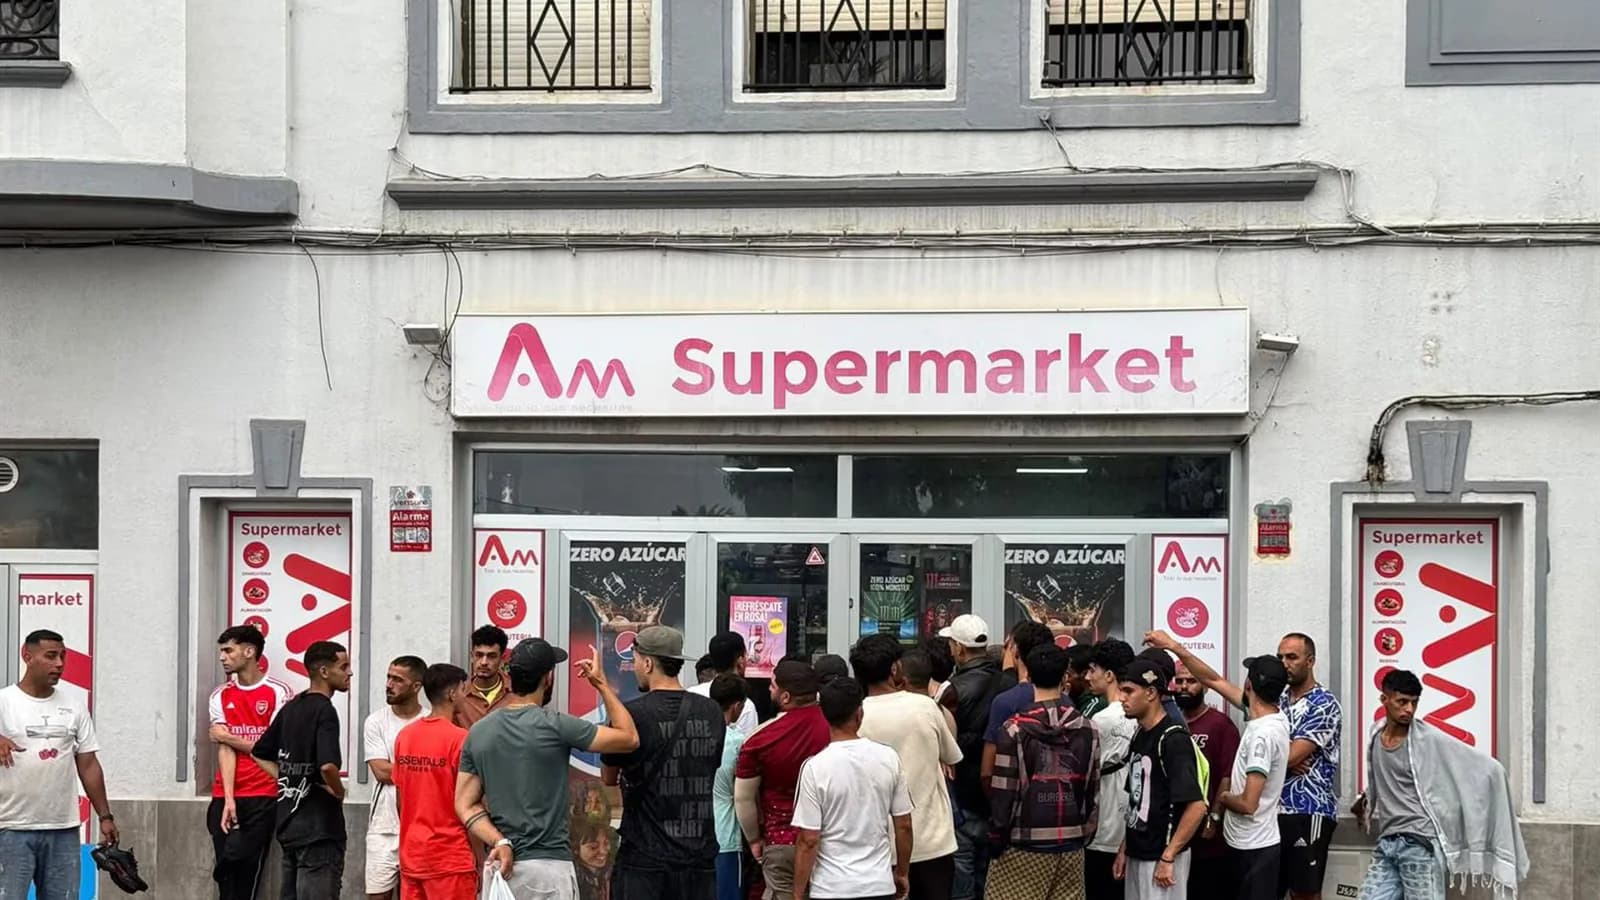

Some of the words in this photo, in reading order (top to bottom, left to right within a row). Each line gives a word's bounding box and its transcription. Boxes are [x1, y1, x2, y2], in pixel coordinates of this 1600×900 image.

[487, 322, 635, 401] Am
[672, 333, 1196, 409] Supermarket
[392, 511, 429, 521] Alarma
[241, 523, 342, 538] Supermarket
[1372, 530, 1484, 546] Supermarket
[479, 534, 539, 567] Am
[571, 547, 616, 562] ZERO
[618, 542, 686, 562] AZÚCAR
[1005, 549, 1050, 564] ZERO
[1053, 544, 1125, 564] AZÚCAR
[1158, 541, 1221, 573] Am
[20, 592, 83, 606] market
